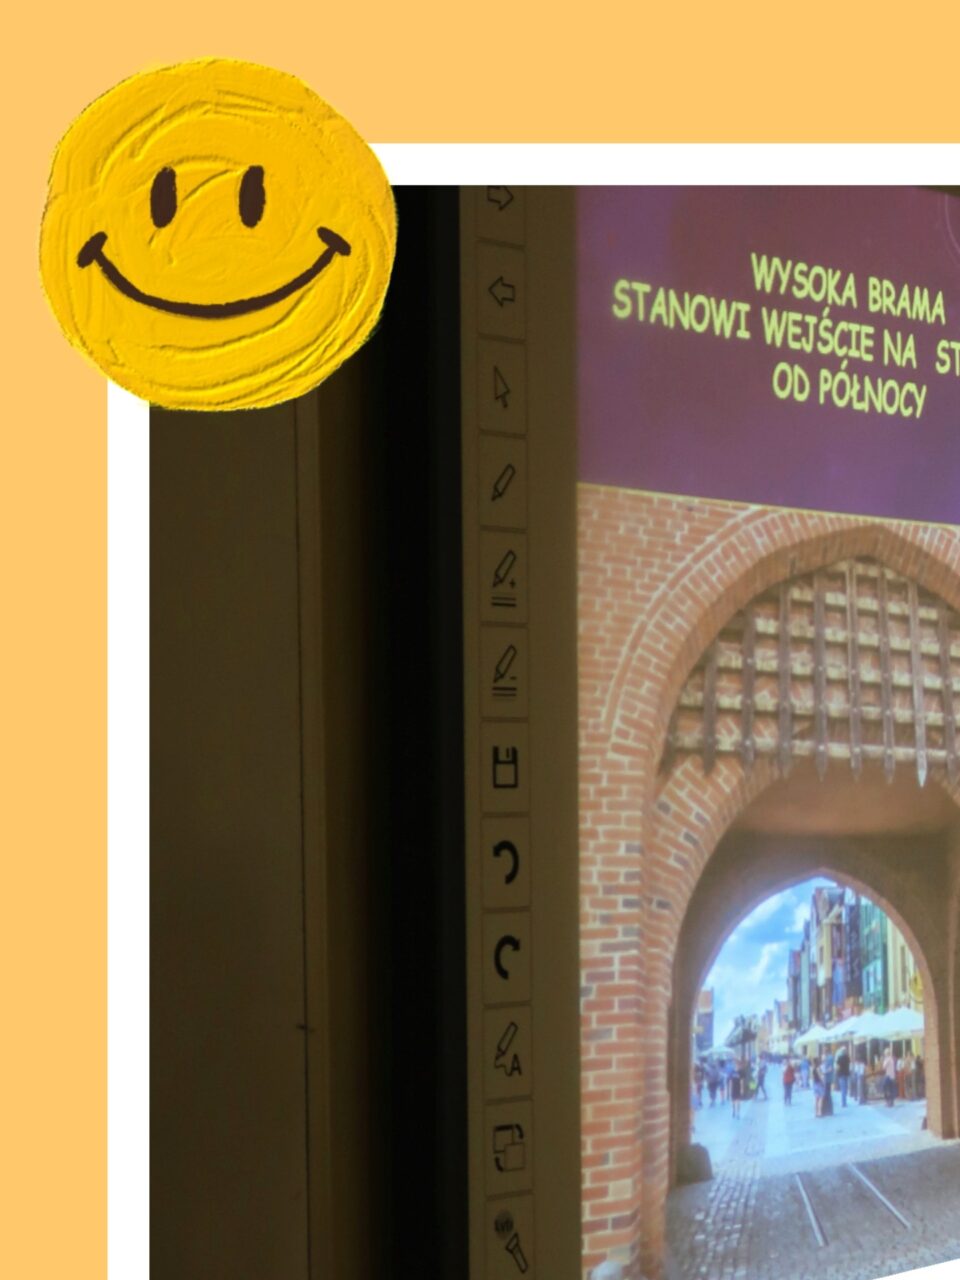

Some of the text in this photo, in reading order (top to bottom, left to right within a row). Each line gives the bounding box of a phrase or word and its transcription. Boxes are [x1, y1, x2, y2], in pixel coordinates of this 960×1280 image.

[611, 278, 751, 340] STANOWI
[761, 306, 874, 363] WEJŚCIE
[883, 331, 917, 369] NA
[750, 252, 946, 325] WYSOKA BRAMA
[772, 359, 927, 419] OD PÓŁNOCY
